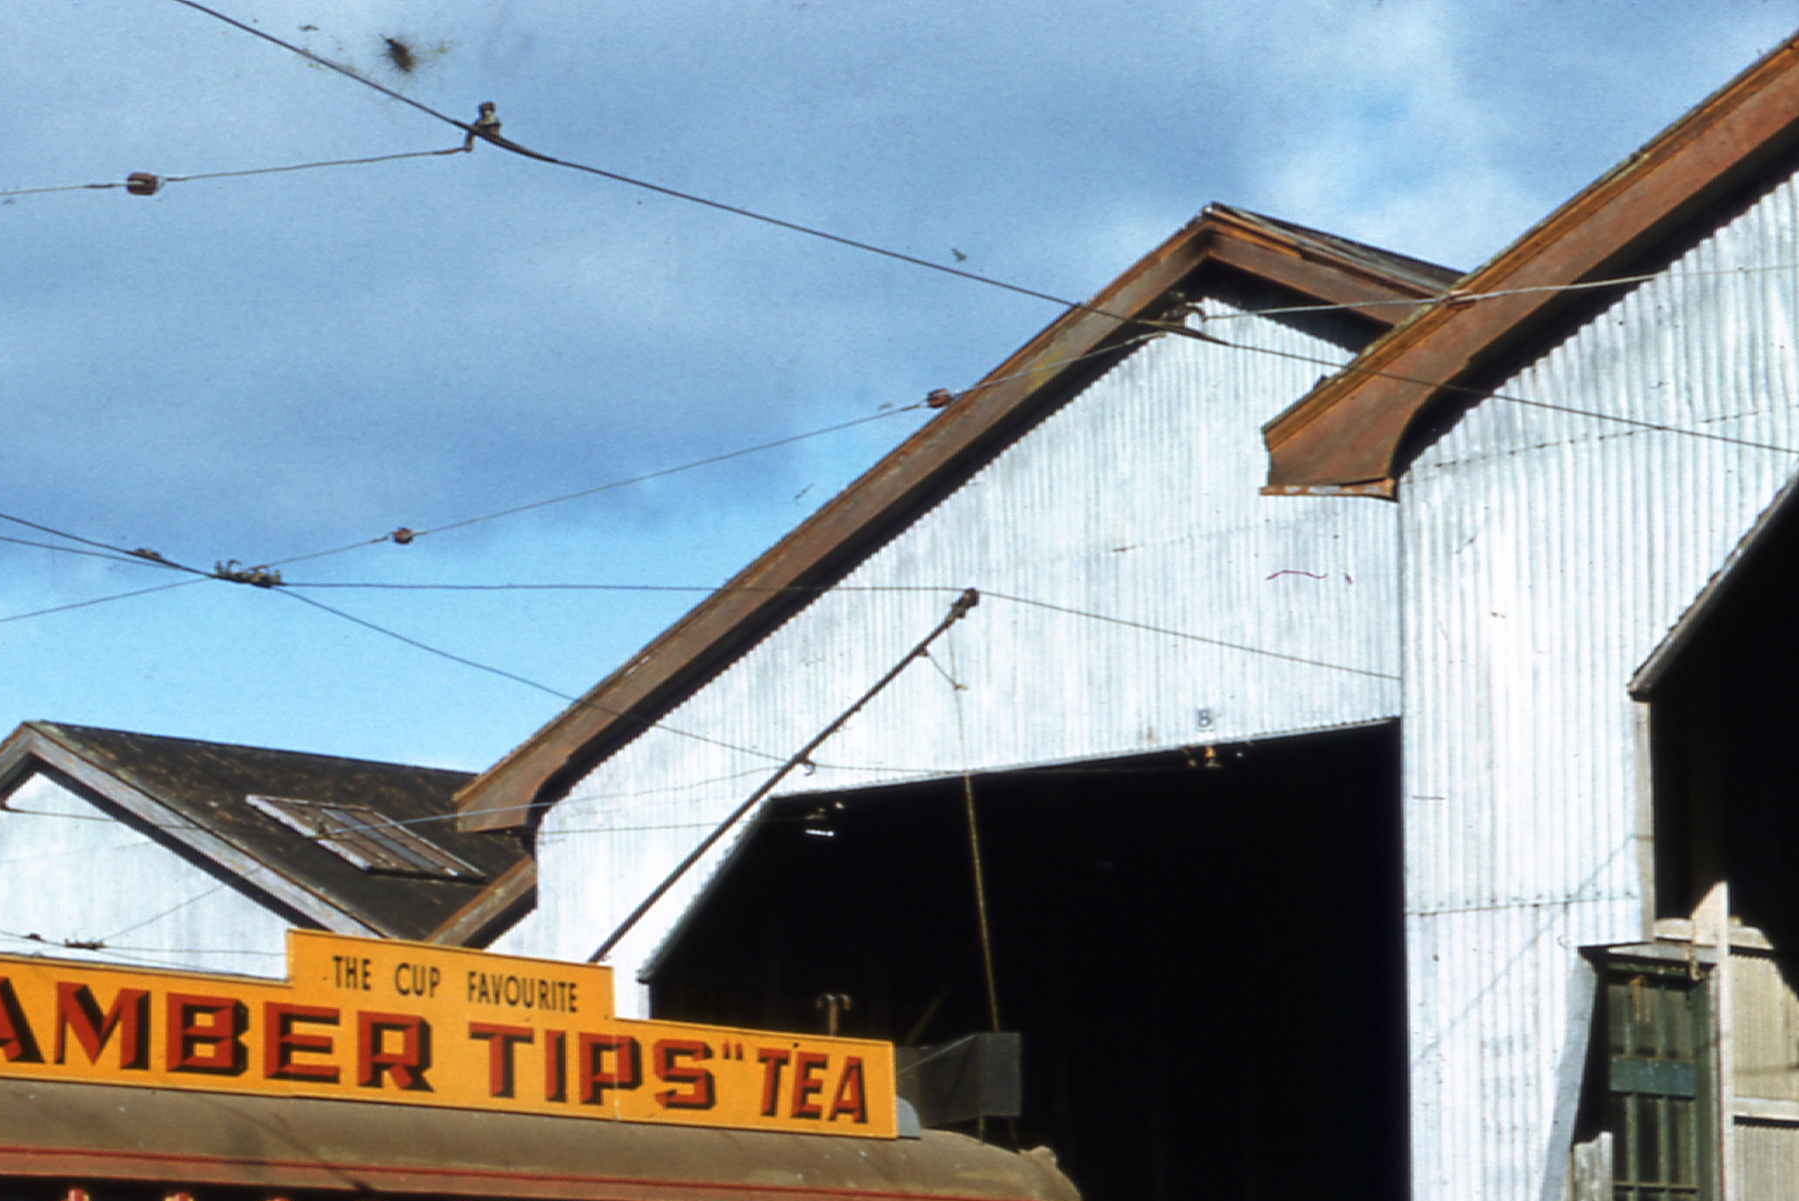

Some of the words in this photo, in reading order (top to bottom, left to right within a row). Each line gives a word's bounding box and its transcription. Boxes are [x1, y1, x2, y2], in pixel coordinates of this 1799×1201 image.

[332, 955, 372, 992] THE
[394, 962, 441, 999] CUP
[467, 970, 579, 1014] FAVOURITE
[468, 1021, 743, 1111] TIPS"
[757, 1046, 869, 1125] TEA
